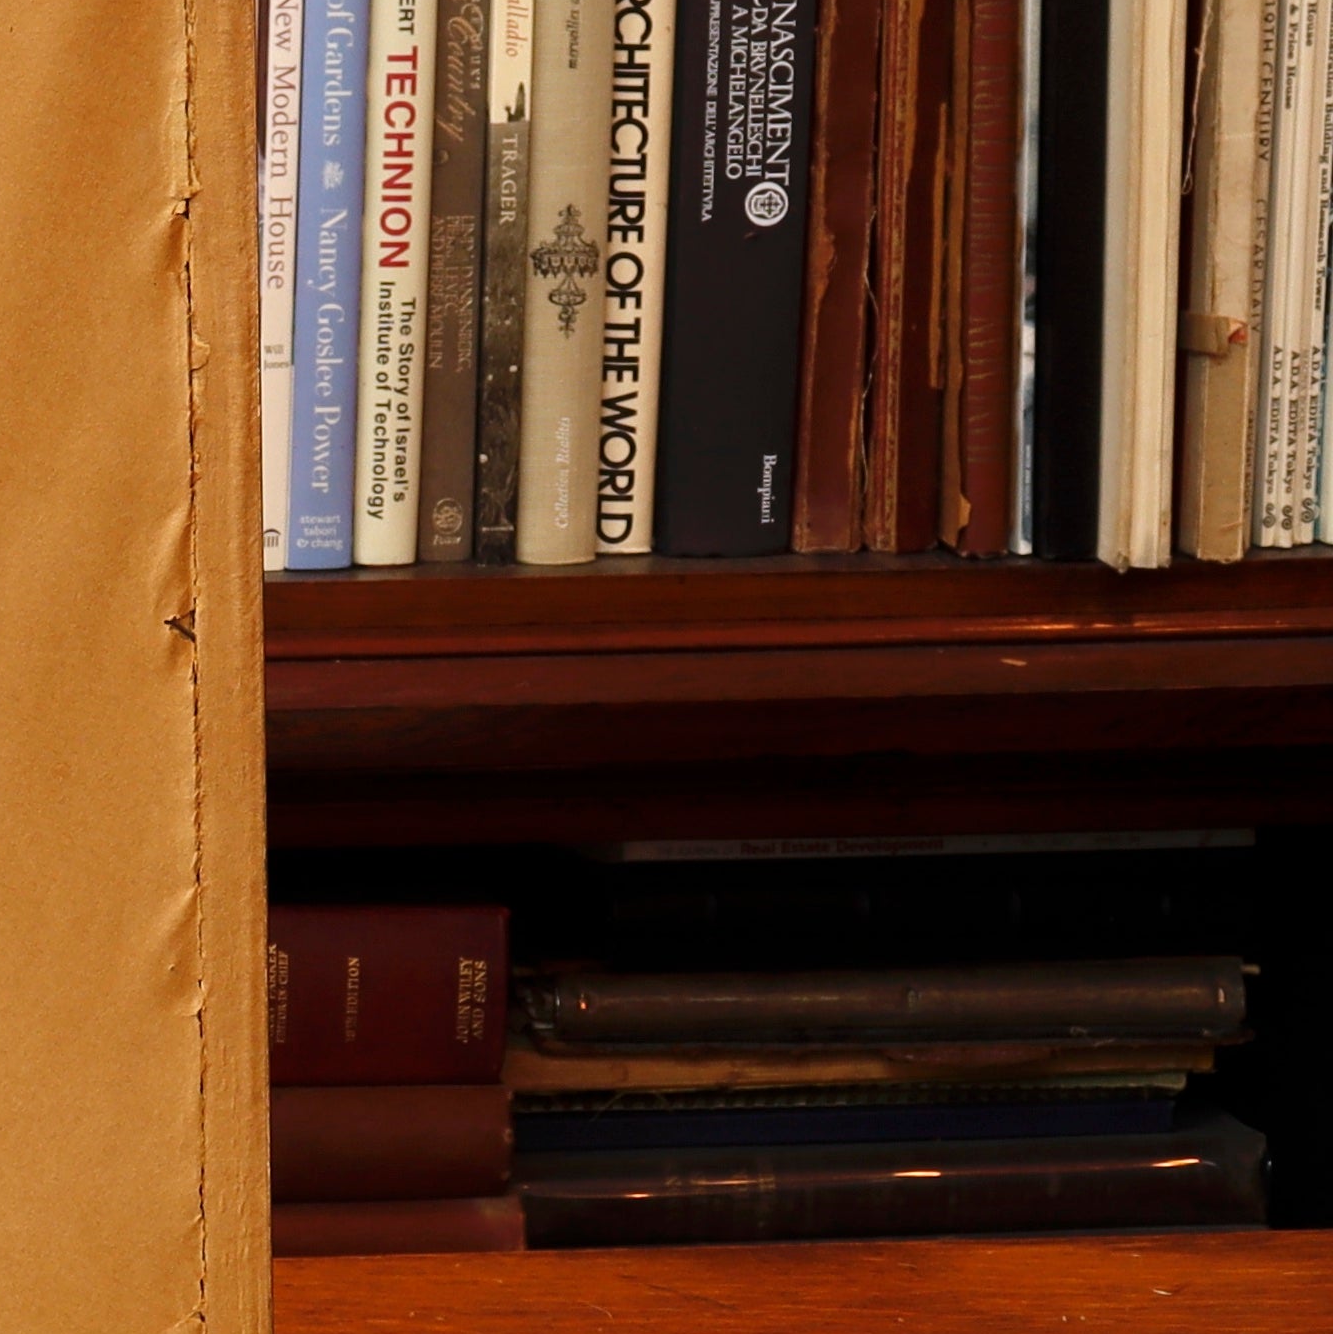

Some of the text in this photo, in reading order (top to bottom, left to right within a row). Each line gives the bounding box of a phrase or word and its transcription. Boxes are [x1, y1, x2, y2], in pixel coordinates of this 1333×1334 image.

[1262, 1, 1276, 53] 19TH
[1287, 22, 1299, 61] Price
[1305, 2, 1318, 47] House
[321, 23, 356, 150] Gardens
[437, 3, 484, 143] Country
[724, 4, 749, 180] A MICHELANGELO
[744, 7, 769, 177] DA BRVNELLESCHI
[1284, 65, 1297, 110] House
[269, 62, 298, 179] Modern
[1257, 60, 1273, 162] CENTURY
[1320, 102, 1333, 165] Building
[378, 45, 421, 269] TECHNION
[498, 133, 519, 225] TRAGER
[1320, 168, 1331, 195] and
[265, 195, 293, 291] House
[1316, 199, 1328, 263] Research
[605, 251, 645, 311] OF
[1314, 266, 1326, 312] Tower
[307, 205, 348, 494] Nancy Goslee Power
[602, 317, 640, 383] THE
[367, 281, 396, 520] Institute of Technology
[393, 297, 417, 503] The Story of Israel's
[1307, 394, 1319, 443] EDITA
[596, 391, 638, 546] WORLD
[1265, 396, 1281, 495] EDITA Tokyo
[1282, 399, 1299, 495] EDITA Tokyo
[1303, 447, 1316, 490] Tokyo
[299, 513, 342, 525] stewart
[554, 468, 571, 529] Collection
[760, 453, 778, 524] Bompiani
[303, 525, 337, 537] tabori
[310, 537, 344, 552] chang
[738, 841, 777, 856] Real
[781, 840, 832, 855] Estate
[835, 836, 944, 856] Development
[346, 956, 361, 1011] EDITION
[454, 955, 473, 1045] JOHN WILEY
[470, 959, 489, 1041] AND SONS
